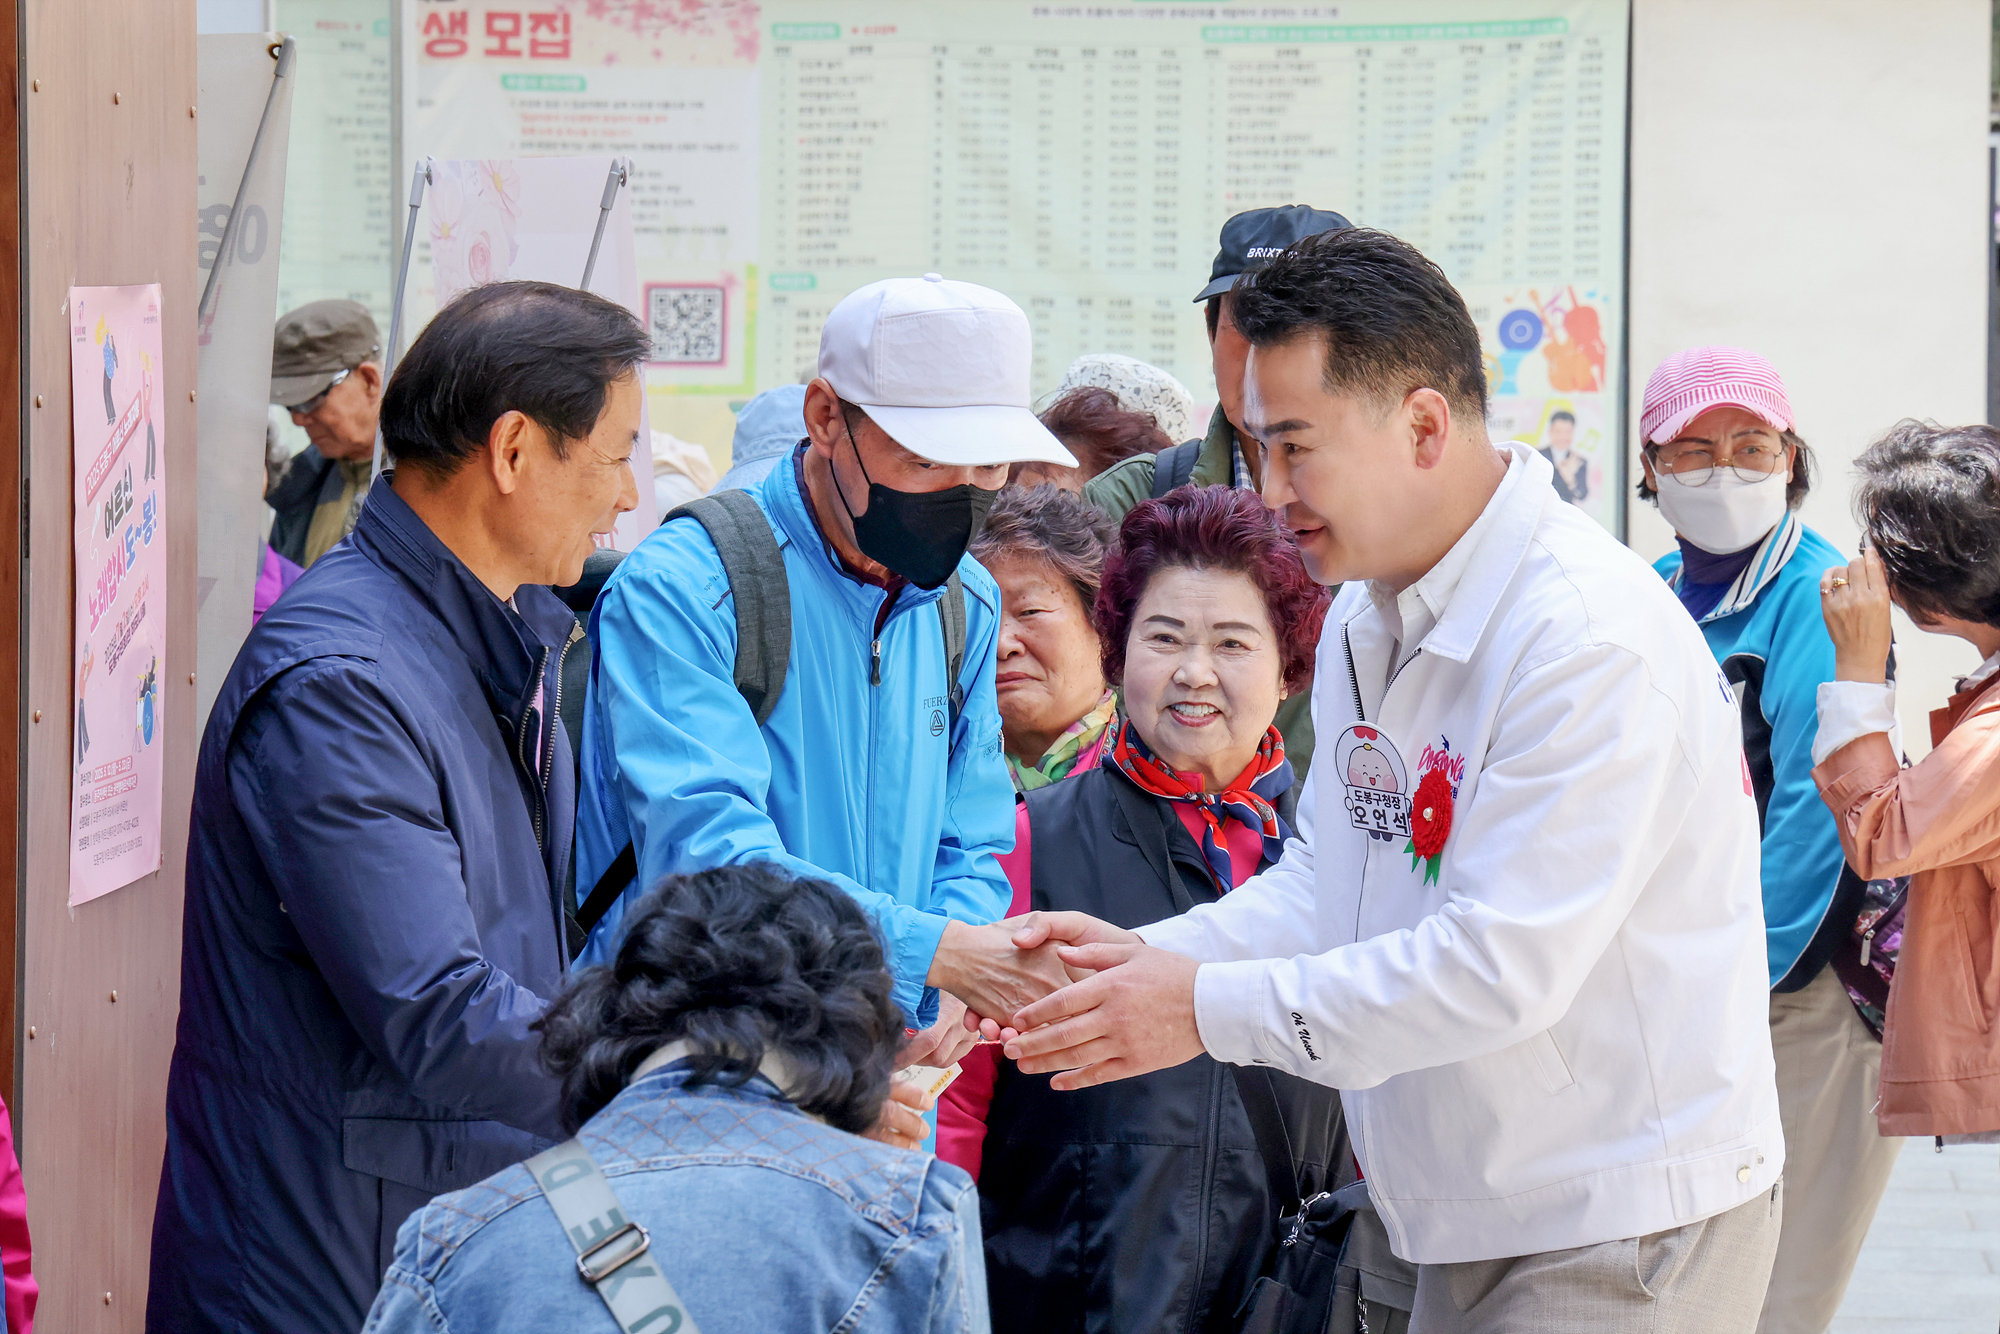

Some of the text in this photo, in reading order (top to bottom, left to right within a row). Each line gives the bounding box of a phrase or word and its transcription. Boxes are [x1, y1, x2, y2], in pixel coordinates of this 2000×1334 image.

[423, 11, 570, 59] 생 모집
[1246, 247, 1298, 259] BRIXT
[104, 461, 134, 540] 어르신
[1354, 789, 1401, 810] 도봉구청장
